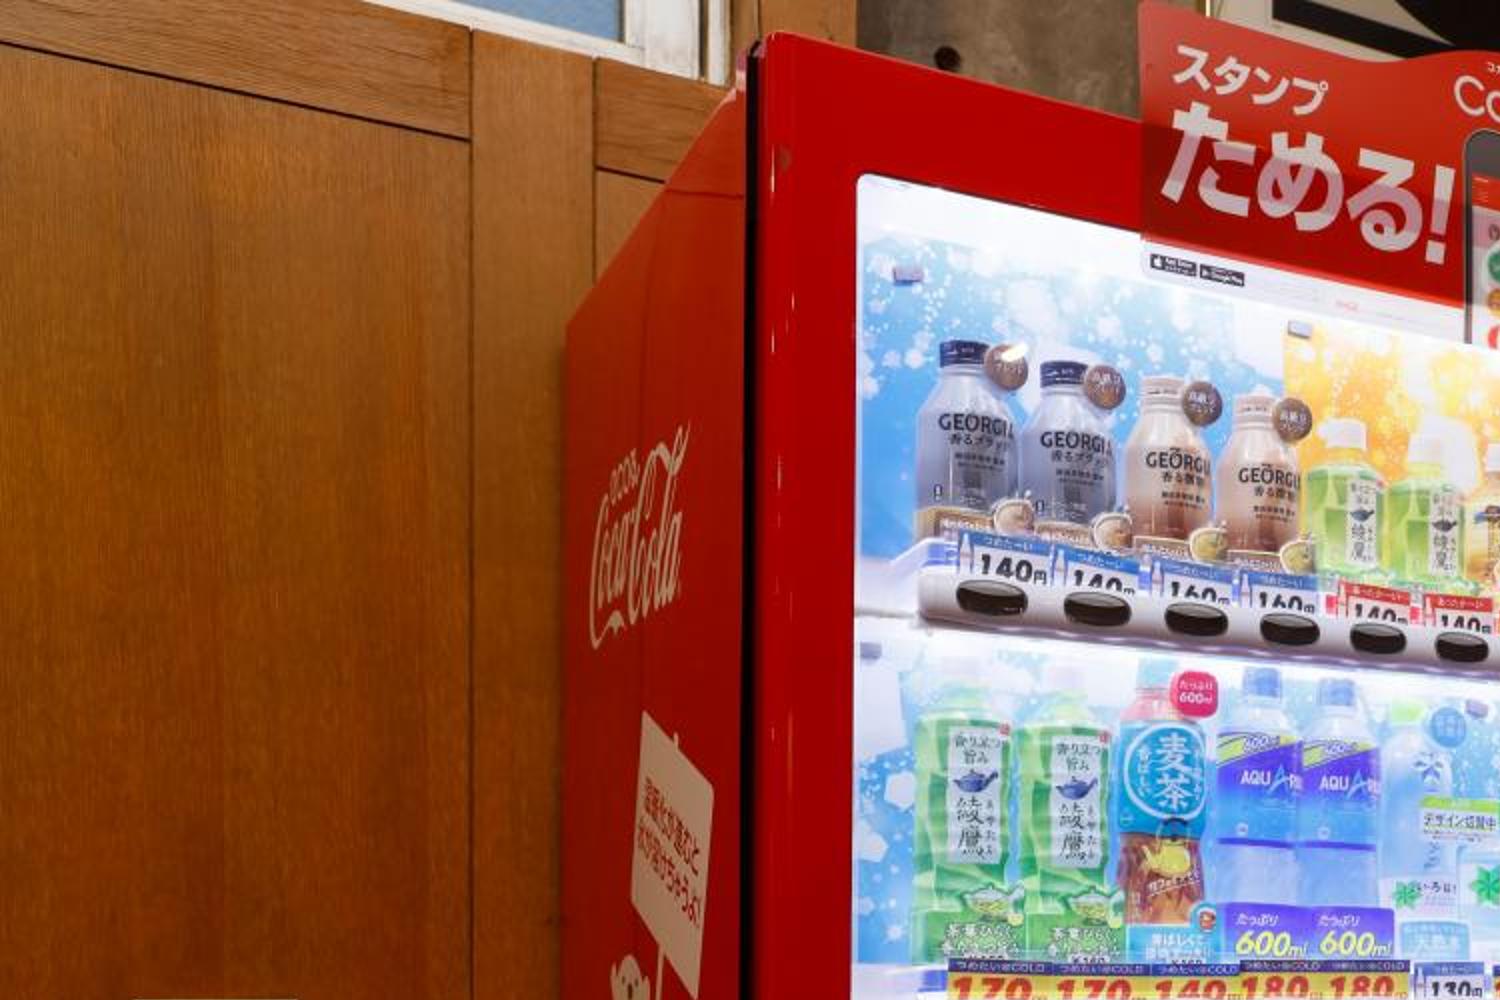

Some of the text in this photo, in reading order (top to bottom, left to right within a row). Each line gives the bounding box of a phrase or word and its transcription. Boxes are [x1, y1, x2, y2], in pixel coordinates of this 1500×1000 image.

[1171, 45, 1329, 116] スタンプ
[1161, 100, 1456, 266] ためる!
[590, 419, 690, 650] Coca-Cola
[978, 553, 1048, 585] 140円
[1153, 732, 1195, 811] 麦茶
[1235, 930, 1310, 957] 600ml
[1320, 930, 1392, 957] 600ml
